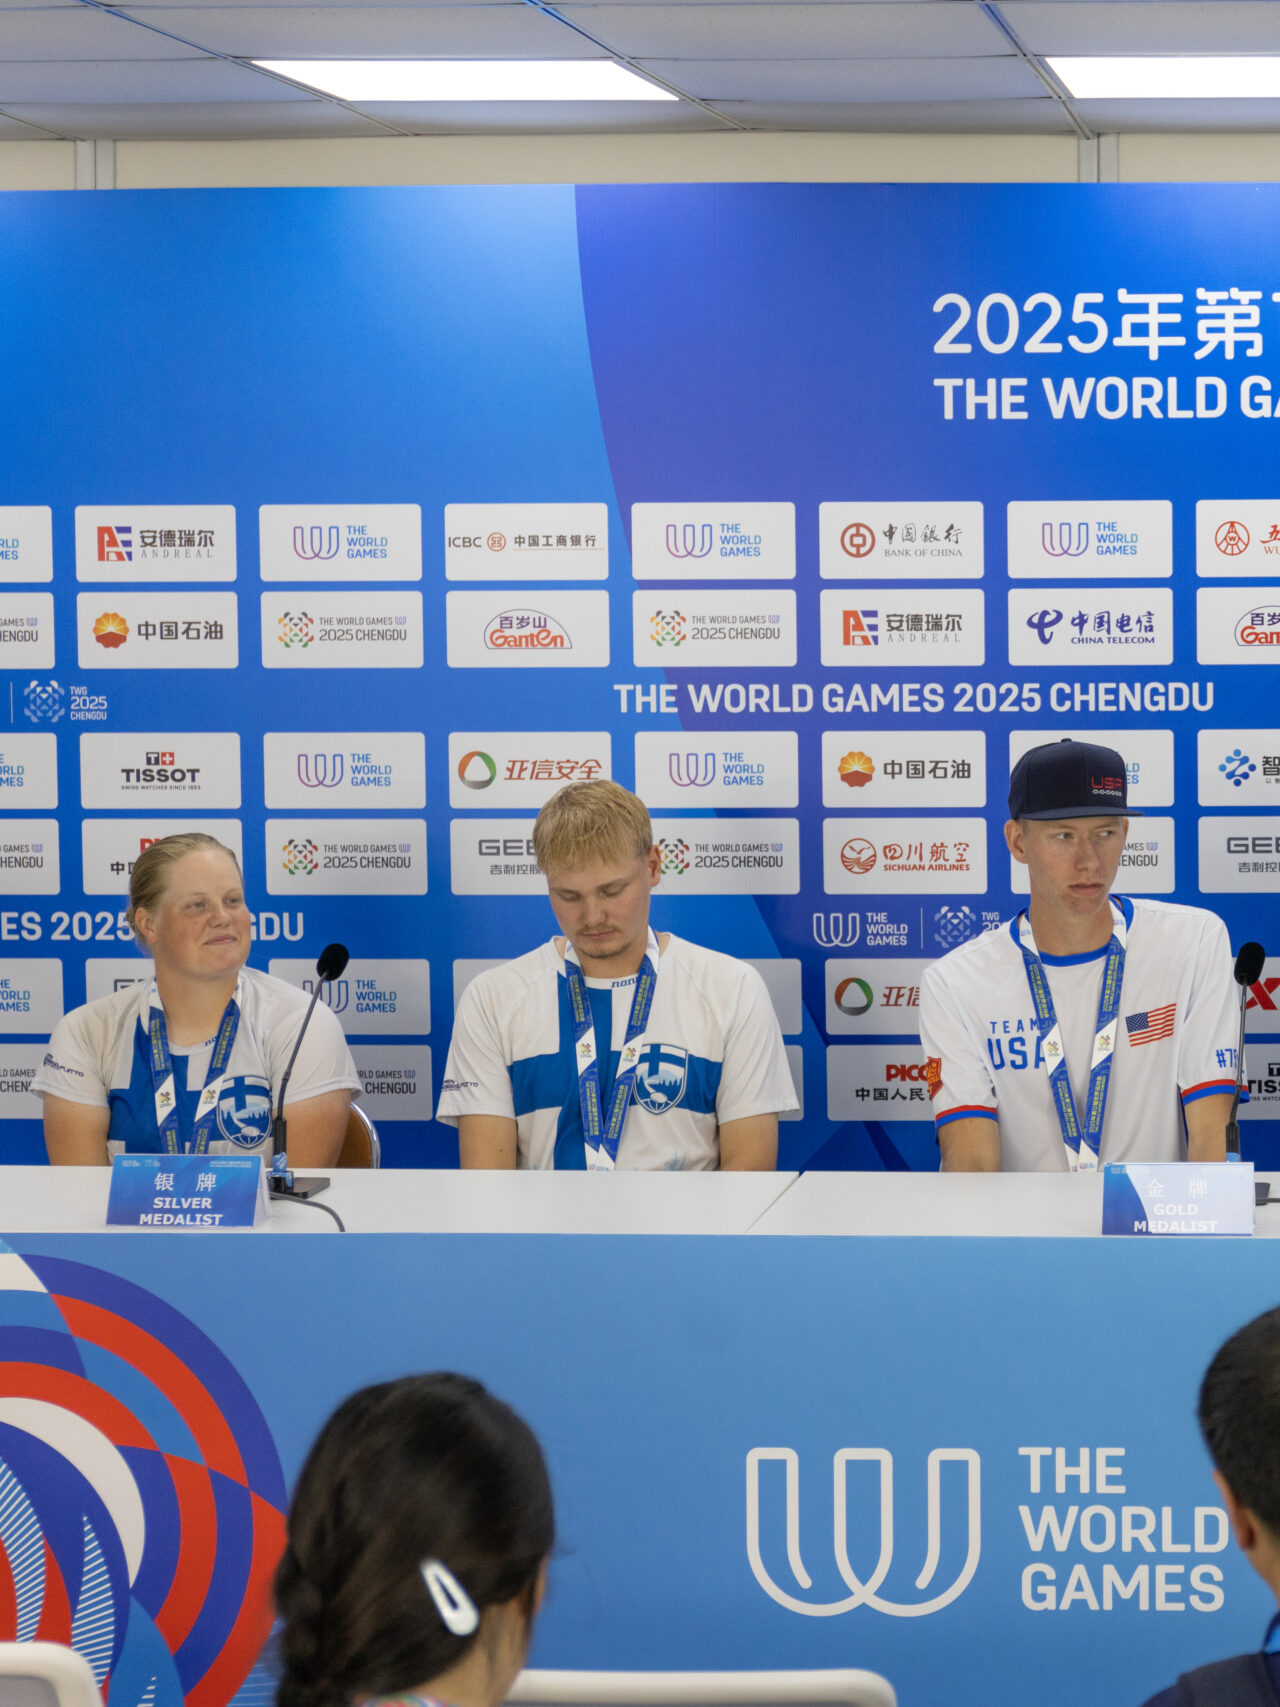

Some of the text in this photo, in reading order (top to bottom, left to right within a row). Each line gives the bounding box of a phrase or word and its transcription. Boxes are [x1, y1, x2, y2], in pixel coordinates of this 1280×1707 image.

[933, 378, 1028, 419] THE
[1042, 376, 1227, 419] WORLD
[140, 530, 214, 547] 安德瑞尔
[347, 537, 387, 547] WORLD
[449, 537, 481, 547] ICBC
[515, 535, 596, 547] 中国工商银行
[141, 549, 212, 558] ANDREAL
[885, 549, 911, 557] BANK
[915, 549, 925, 557] OF
[320, 617, 393, 626] THE WORLD GAMES
[499, 615, 547, 629] 百岁山
[886, 614, 962, 632] 安德瑞尔
[1071, 610, 1154, 636] 中国电信
[138, 621, 223, 640] 中国石油
[319, 629, 406, 641] 2025 CHENGDU
[692, 627, 780, 640] 2025 CHENGDU
[888, 633, 960, 642] ANDREAL
[70, 686, 87, 695] TWG
[71, 696, 107, 709] 2025
[613, 682, 1213, 713] THE WORLD GAMES 2025 CHENGDU
[71, 711, 107, 720] CHENGDU
[351, 754, 371, 763] THE
[121, 769, 200, 782] TISSOT
[351, 765, 391, 775] WORLD
[504, 759, 602, 782] 亚信安全
[884, 760, 971, 779] 中国石油
[351, 777, 391, 786] GAMES
[324, 844, 397, 853] THE WORLD GAMES
[695, 844, 769, 852] THE WORLD GAMES
[883, 842, 969, 862] 四川航空
[324, 856, 411, 869] 2025 CHENGDU
[695, 856, 783, 868] 2025 CHENGDU
[866, 913, 887, 922] THE
[982, 912, 999, 921] TWG
[867, 924, 908, 934] WORLD
[867, 935, 907, 945] GAMES
[990, 1018, 1040, 1034] TEAM
[365, 1082, 416, 1094] CHENGDU
[154, 1172, 216, 1192] 银 牌
[153, 1197, 212, 1208] SILVER
[1154, 1203, 1199, 1216] GOLD
[139, 1213, 223, 1225] MEDALIST
[1134, 1220, 1217, 1233] MEDALIST
[1018, 1447, 1126, 1494] THE
[1018, 1505, 1229, 1553] WORLD
[1022, 1563, 1224, 1612] GAMES
